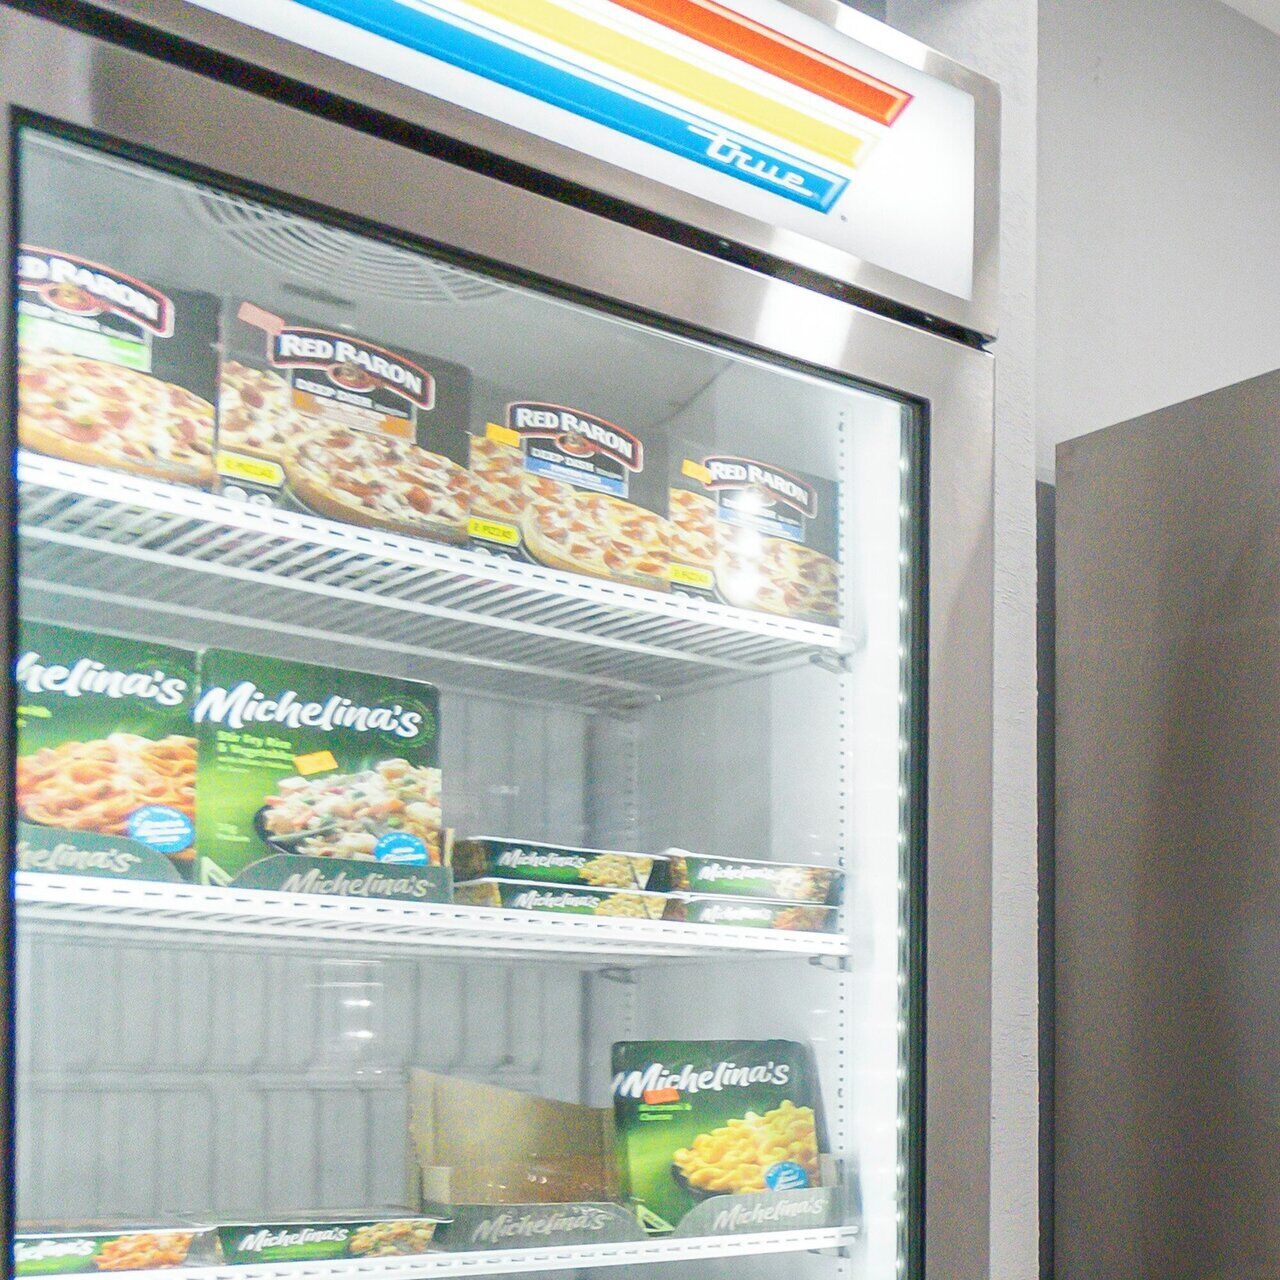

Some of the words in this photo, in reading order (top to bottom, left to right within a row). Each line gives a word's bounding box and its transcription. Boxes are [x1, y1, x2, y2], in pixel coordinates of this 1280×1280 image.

[280, 333, 332, 361] RED
[517, 407, 559, 430] RED
[711, 461, 746, 482] RED
[194, 681, 422, 738] Michelina's
[281, 868, 429, 896] Michelina's
[613, 1061, 789, 1098] Michelina's
[238, 1227, 349, 1252] Michelina's
